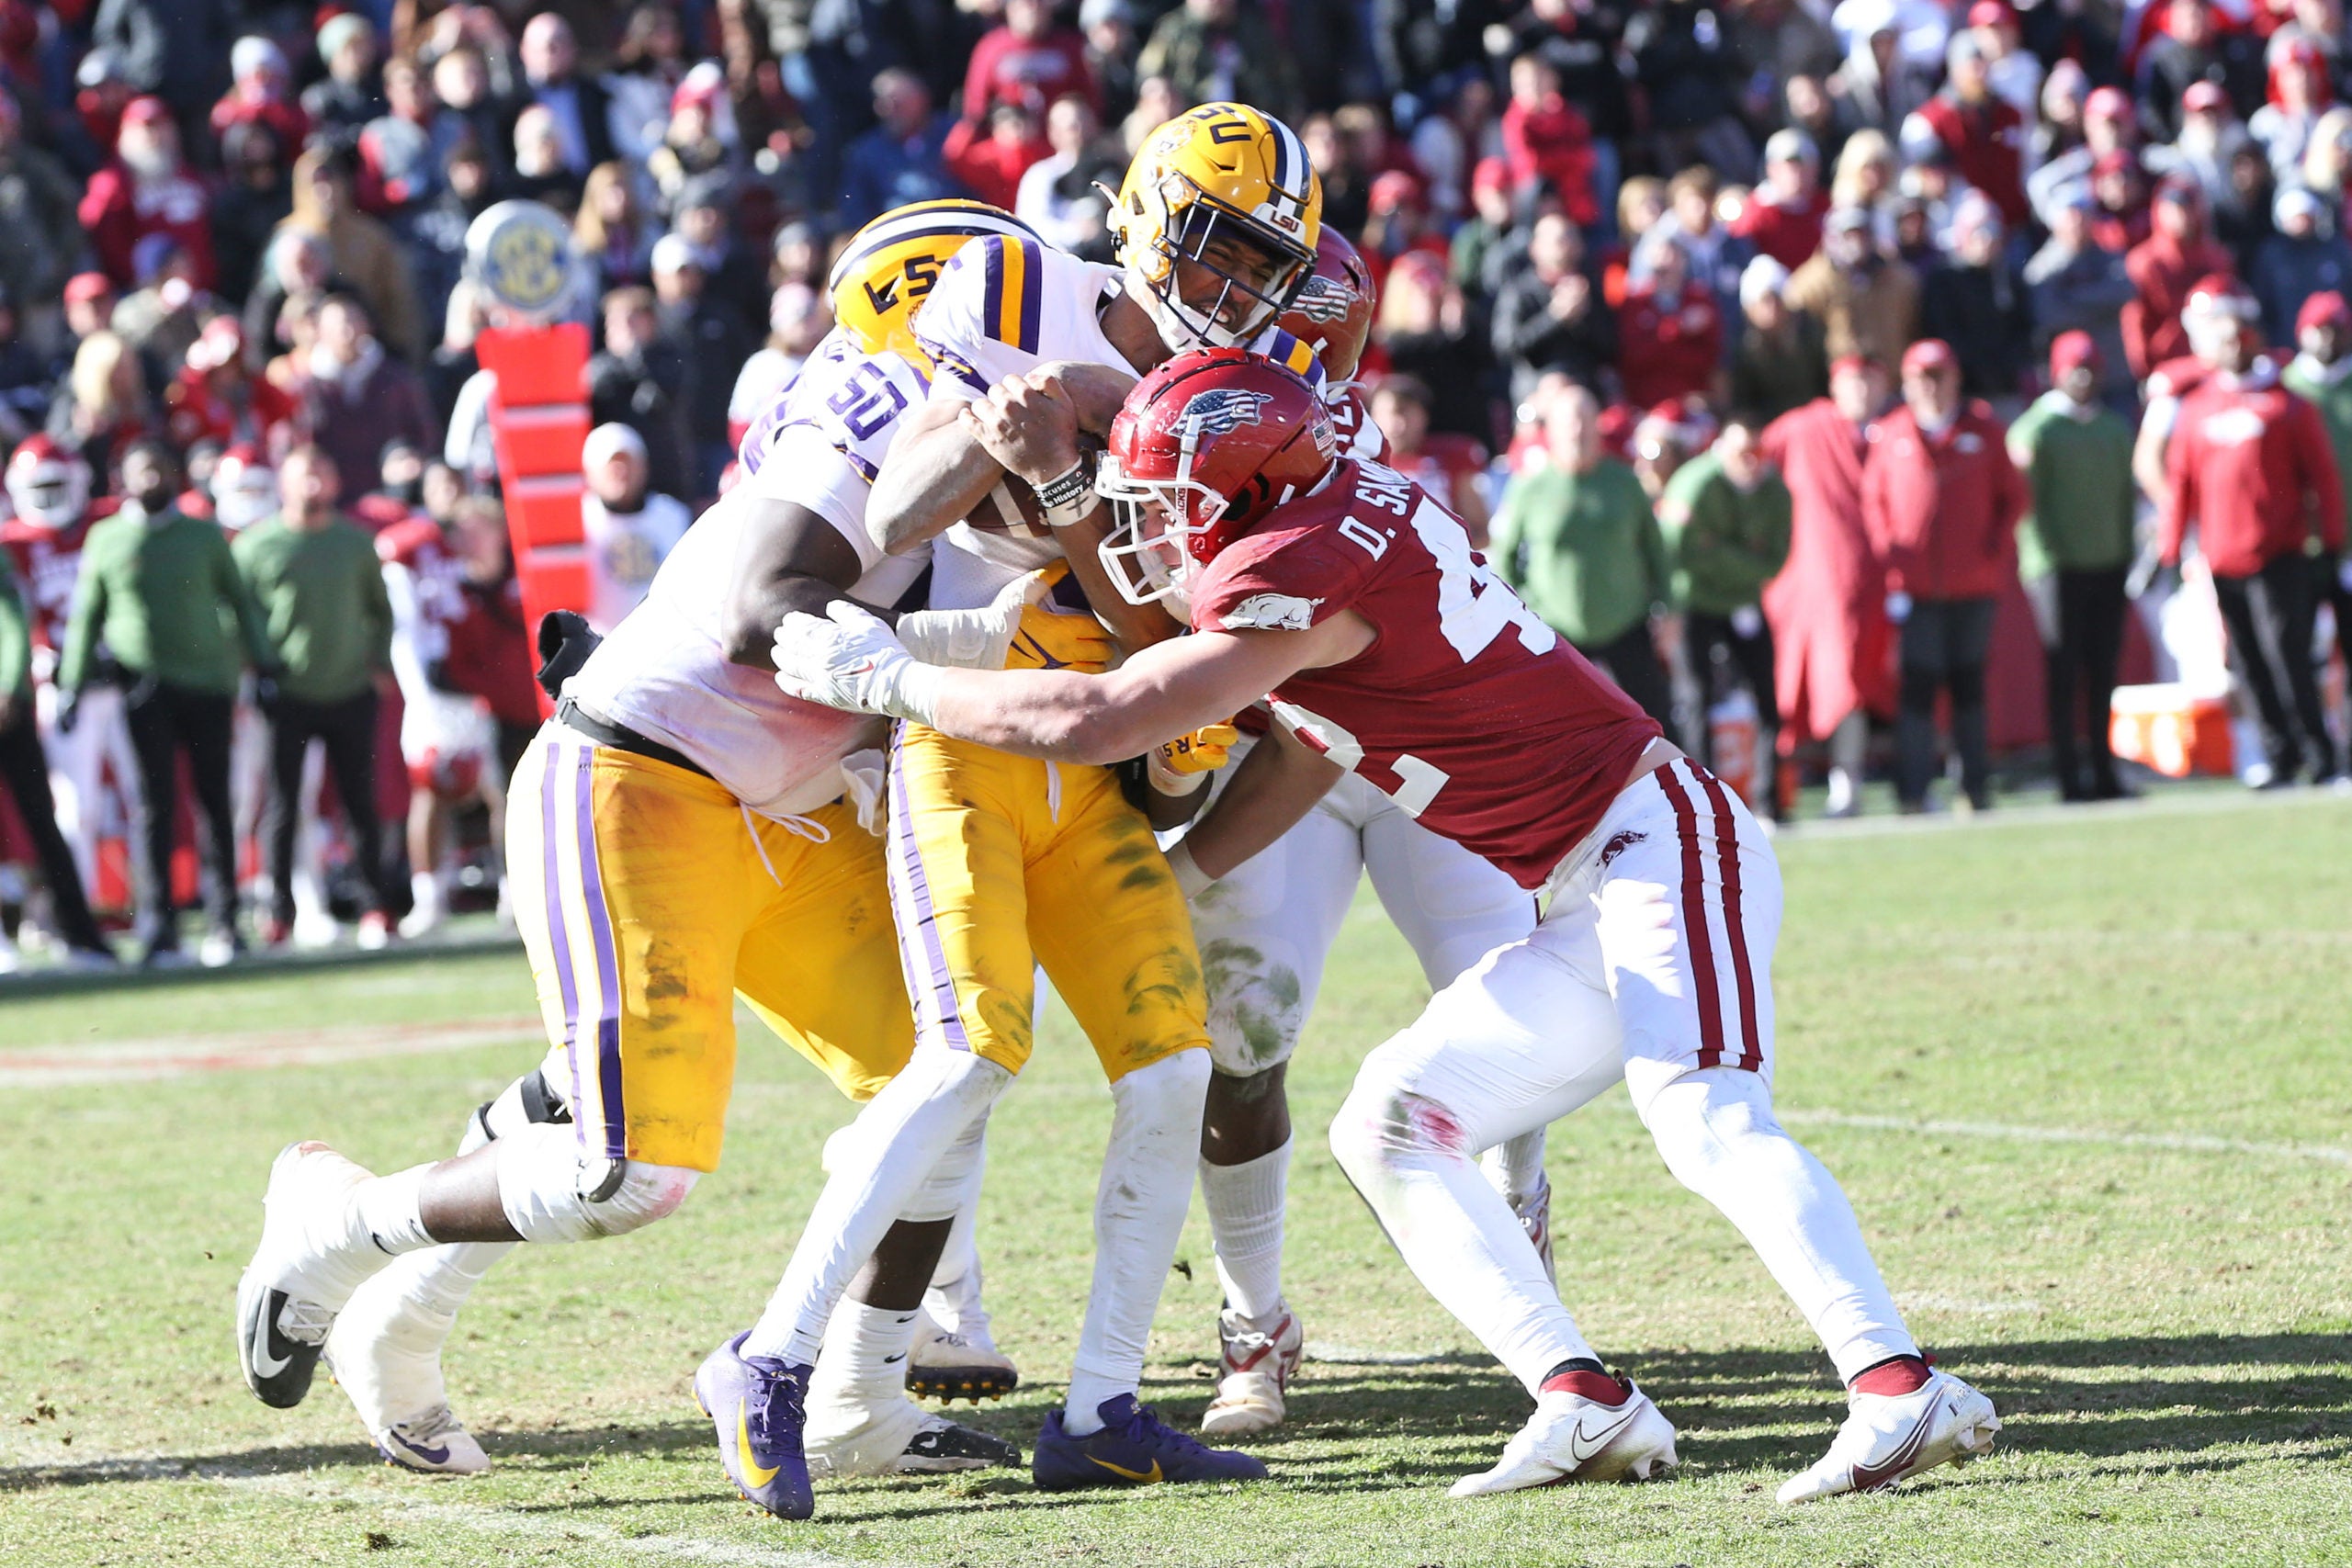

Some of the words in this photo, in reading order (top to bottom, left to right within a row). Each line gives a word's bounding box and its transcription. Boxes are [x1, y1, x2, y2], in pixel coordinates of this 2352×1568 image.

[1270, 209, 1300, 233] LSU
[863, 254, 947, 316] LS
[826, 361, 909, 442] 50
[1042, 479, 1072, 499] cuses
[1052, 483, 1084, 505] History
[1177, 487, 1188, 518] ACKS
[1338, 514, 1396, 563] D.
